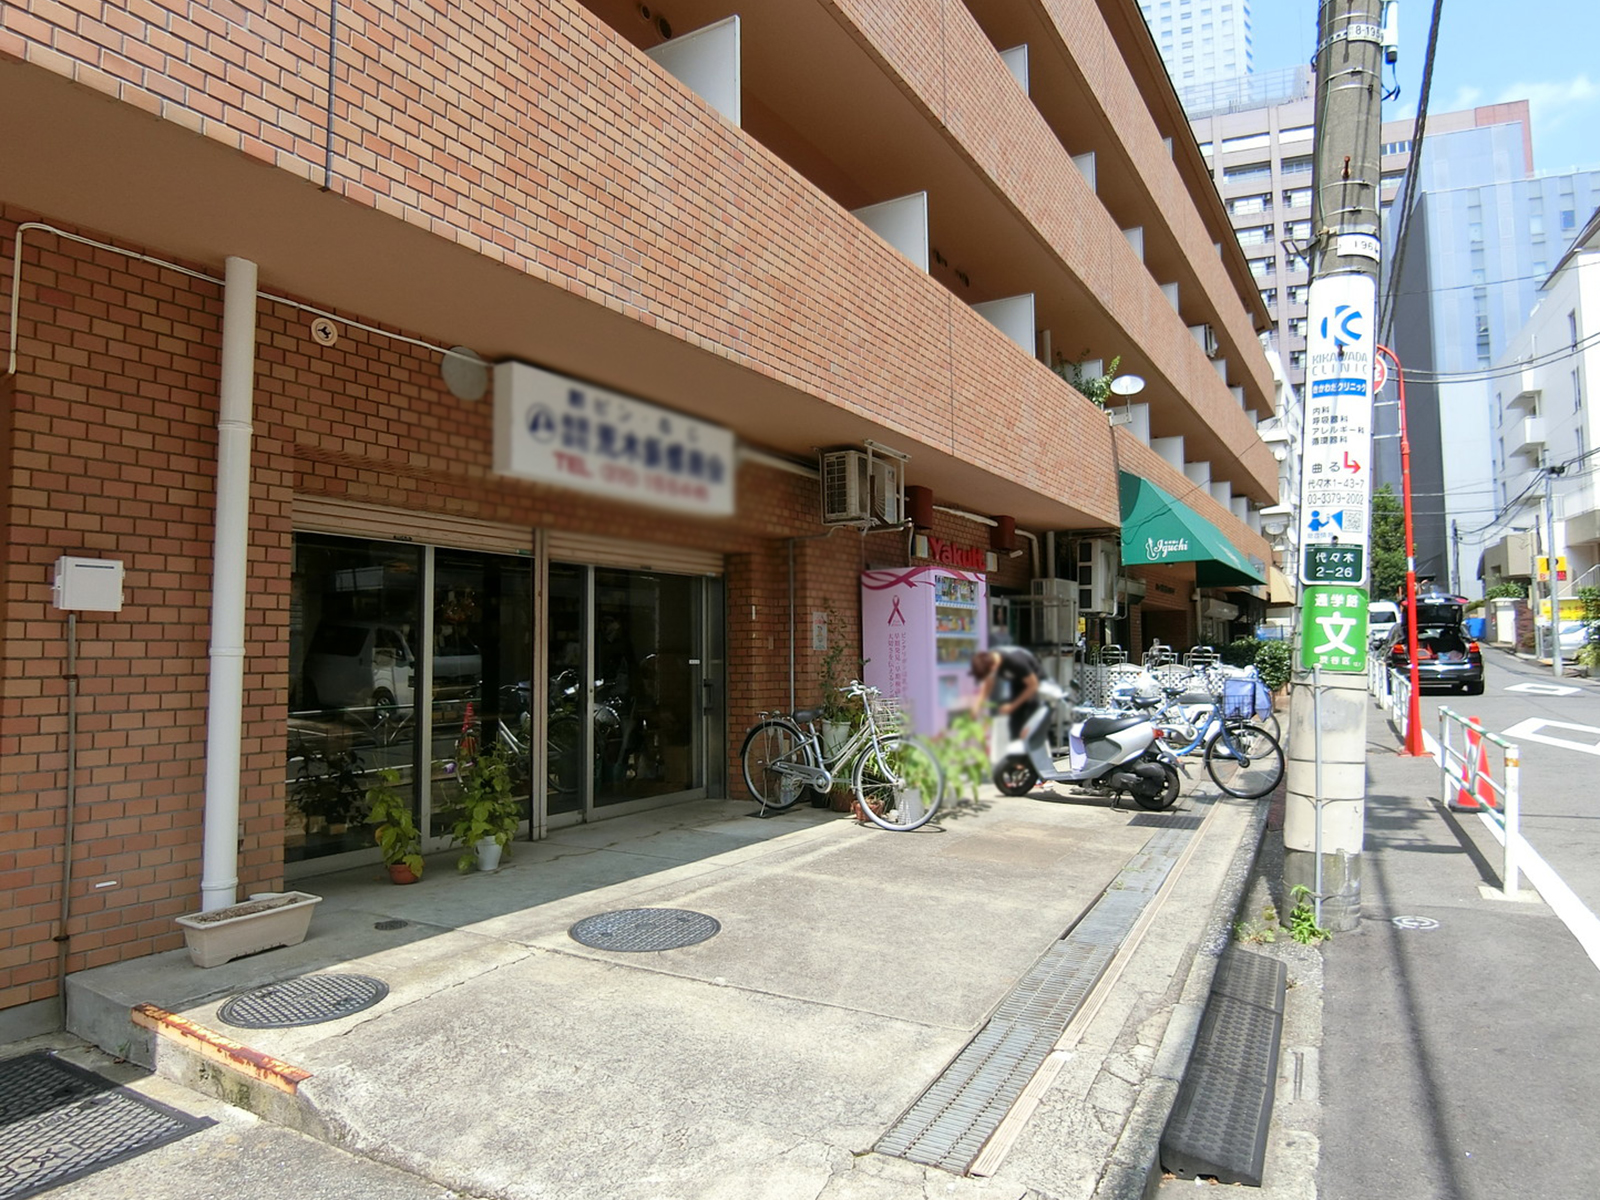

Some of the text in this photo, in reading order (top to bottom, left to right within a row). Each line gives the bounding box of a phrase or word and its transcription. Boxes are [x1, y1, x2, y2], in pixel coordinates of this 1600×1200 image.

[1312, 363, 1367, 376] CLINIC
[1312, 406, 1330, 416] 内科
[1312, 415, 1348, 425] 呼吸器科
[1312, 426, 1364, 435] アレルギー科
[1312, 461, 1341, 474] 曲る
[928, 535, 987, 572] Yakult
[1153, 538, 1188, 558] Iguchi
[1315, 552, 1355, 564] 代々木
[1315, 566, 1353, 578] 2-26
[1315, 593, 1359, 608] 通学路
[1313, 611, 1357, 655] 文
